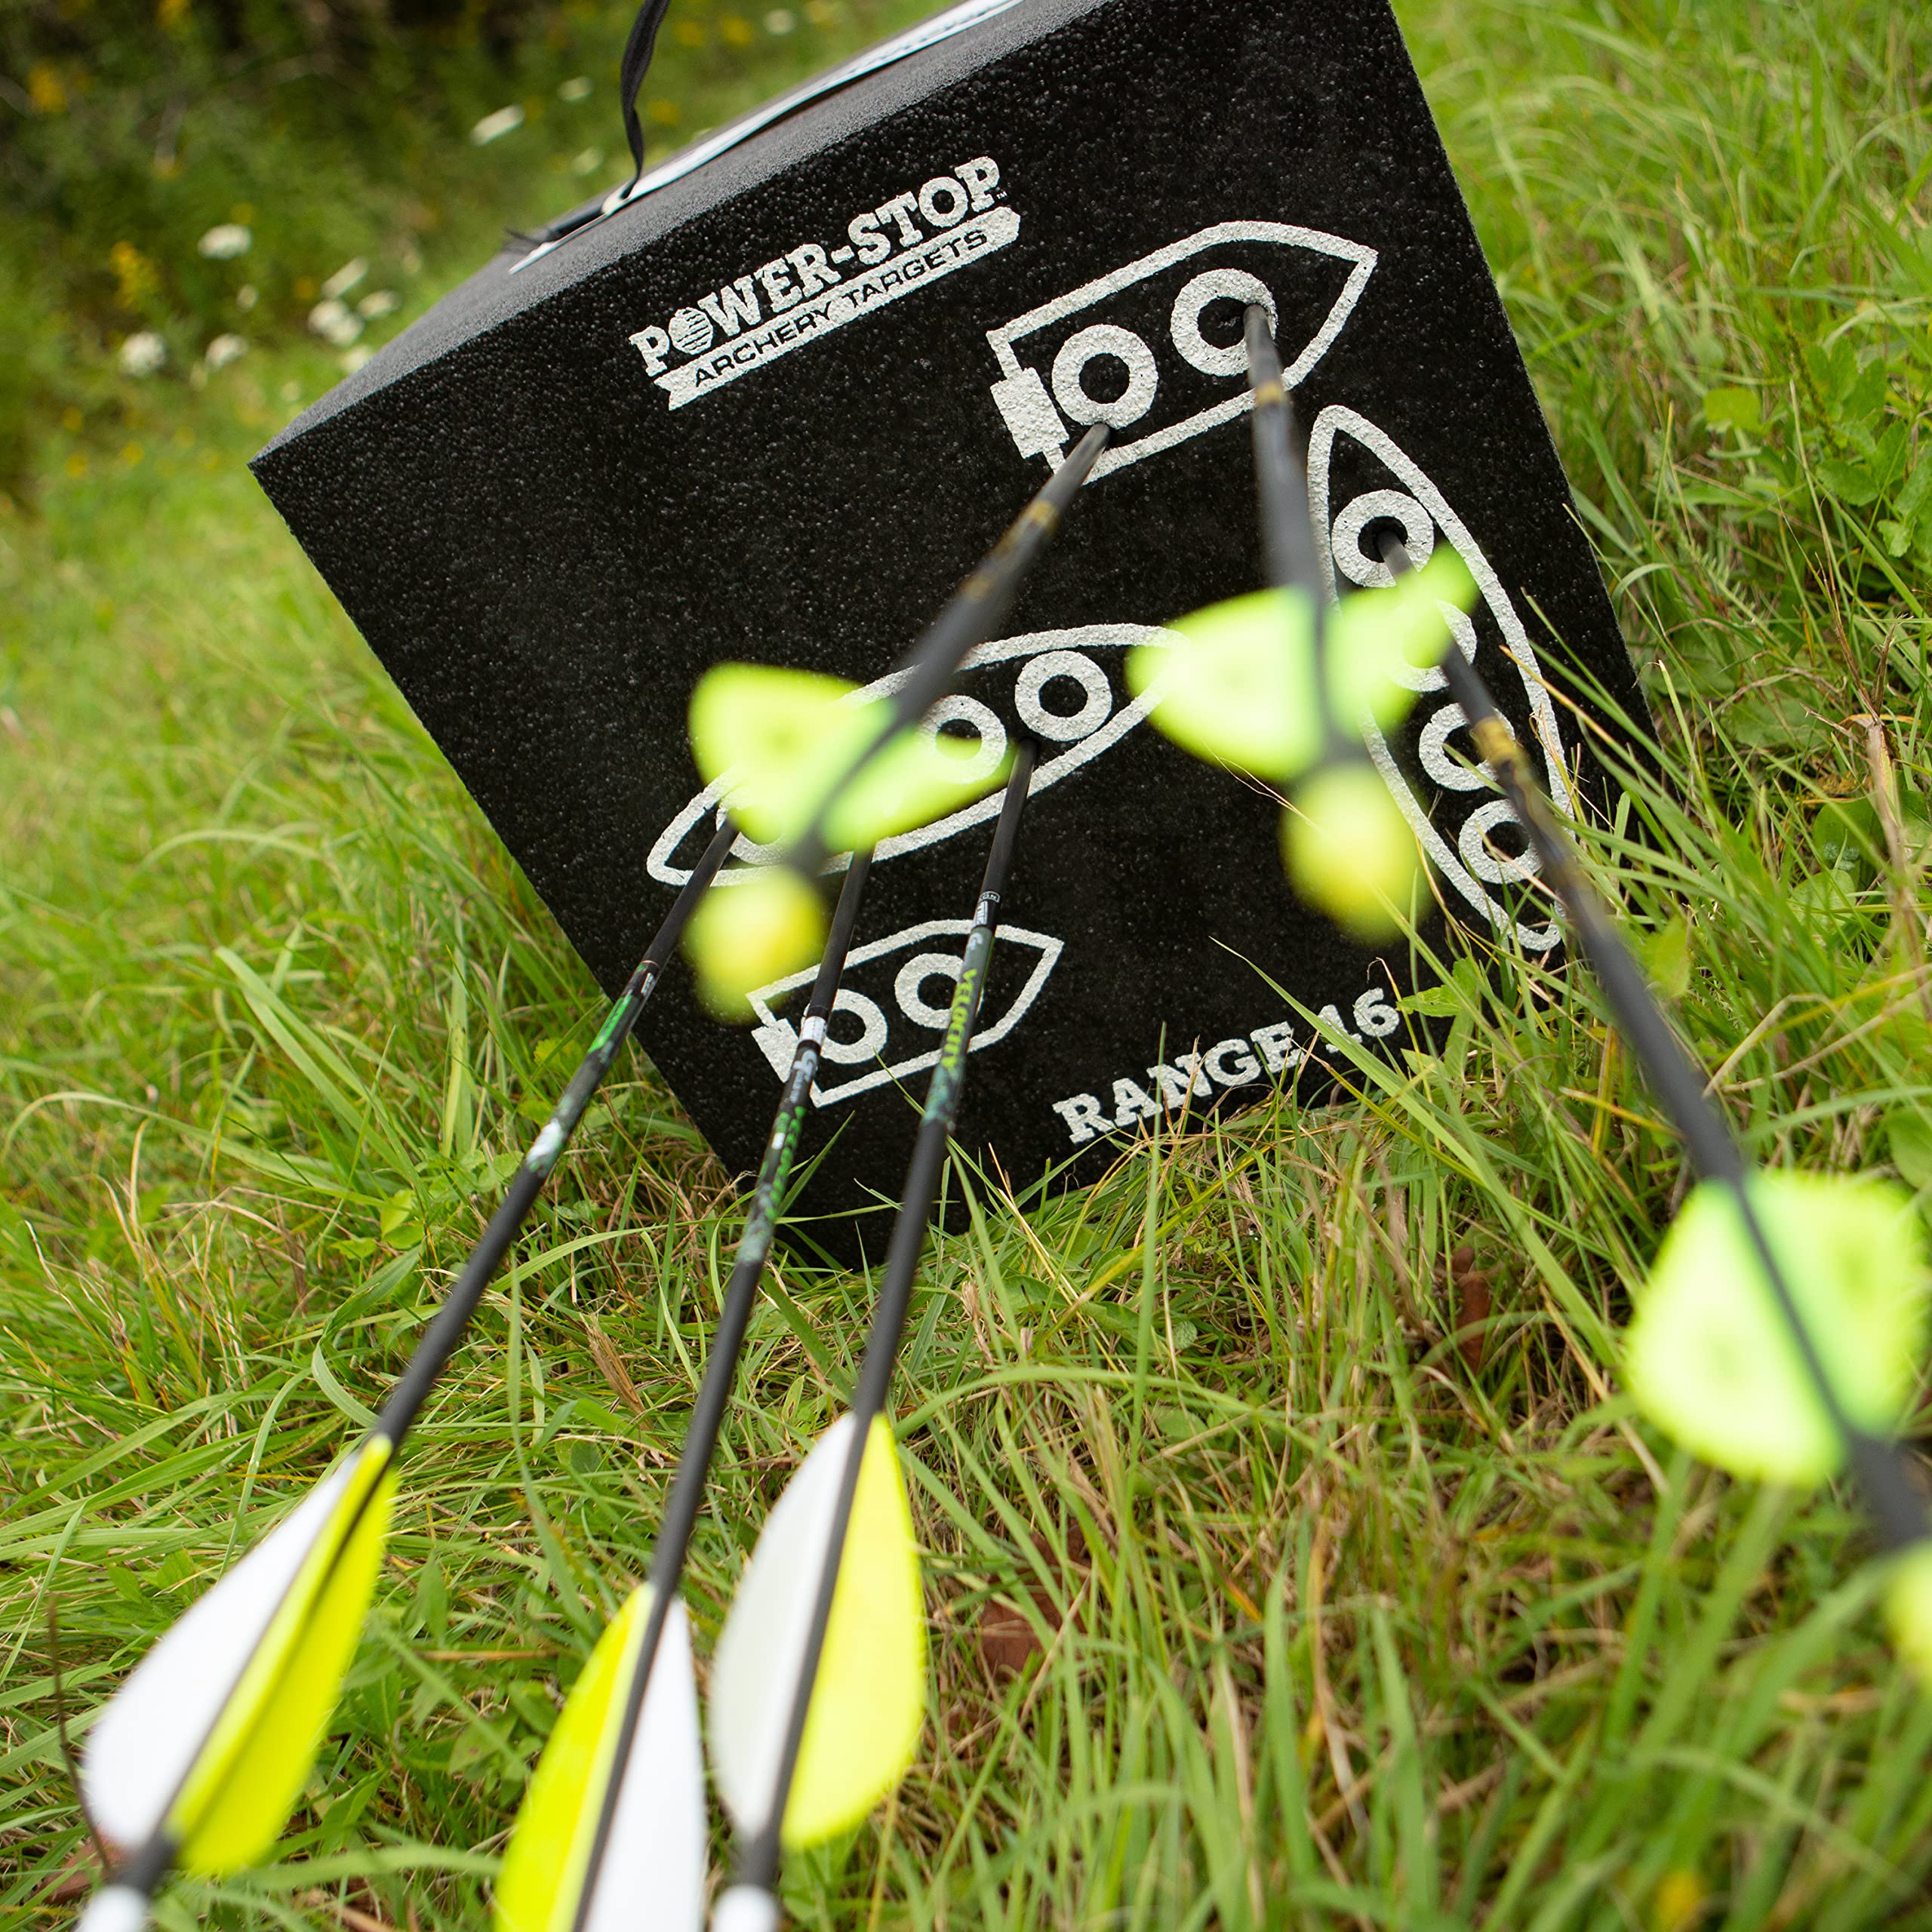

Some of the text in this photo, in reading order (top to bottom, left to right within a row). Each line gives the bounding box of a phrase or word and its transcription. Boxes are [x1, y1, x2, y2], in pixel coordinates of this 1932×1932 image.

[629, 156, 1000, 377] POWER-STOP
[695, 228, 989, 387] ARCHERY TARGETS
[940, 968, 977, 1073] VELOCITY
[1052, 1021, 1305, 1144] RANGE
